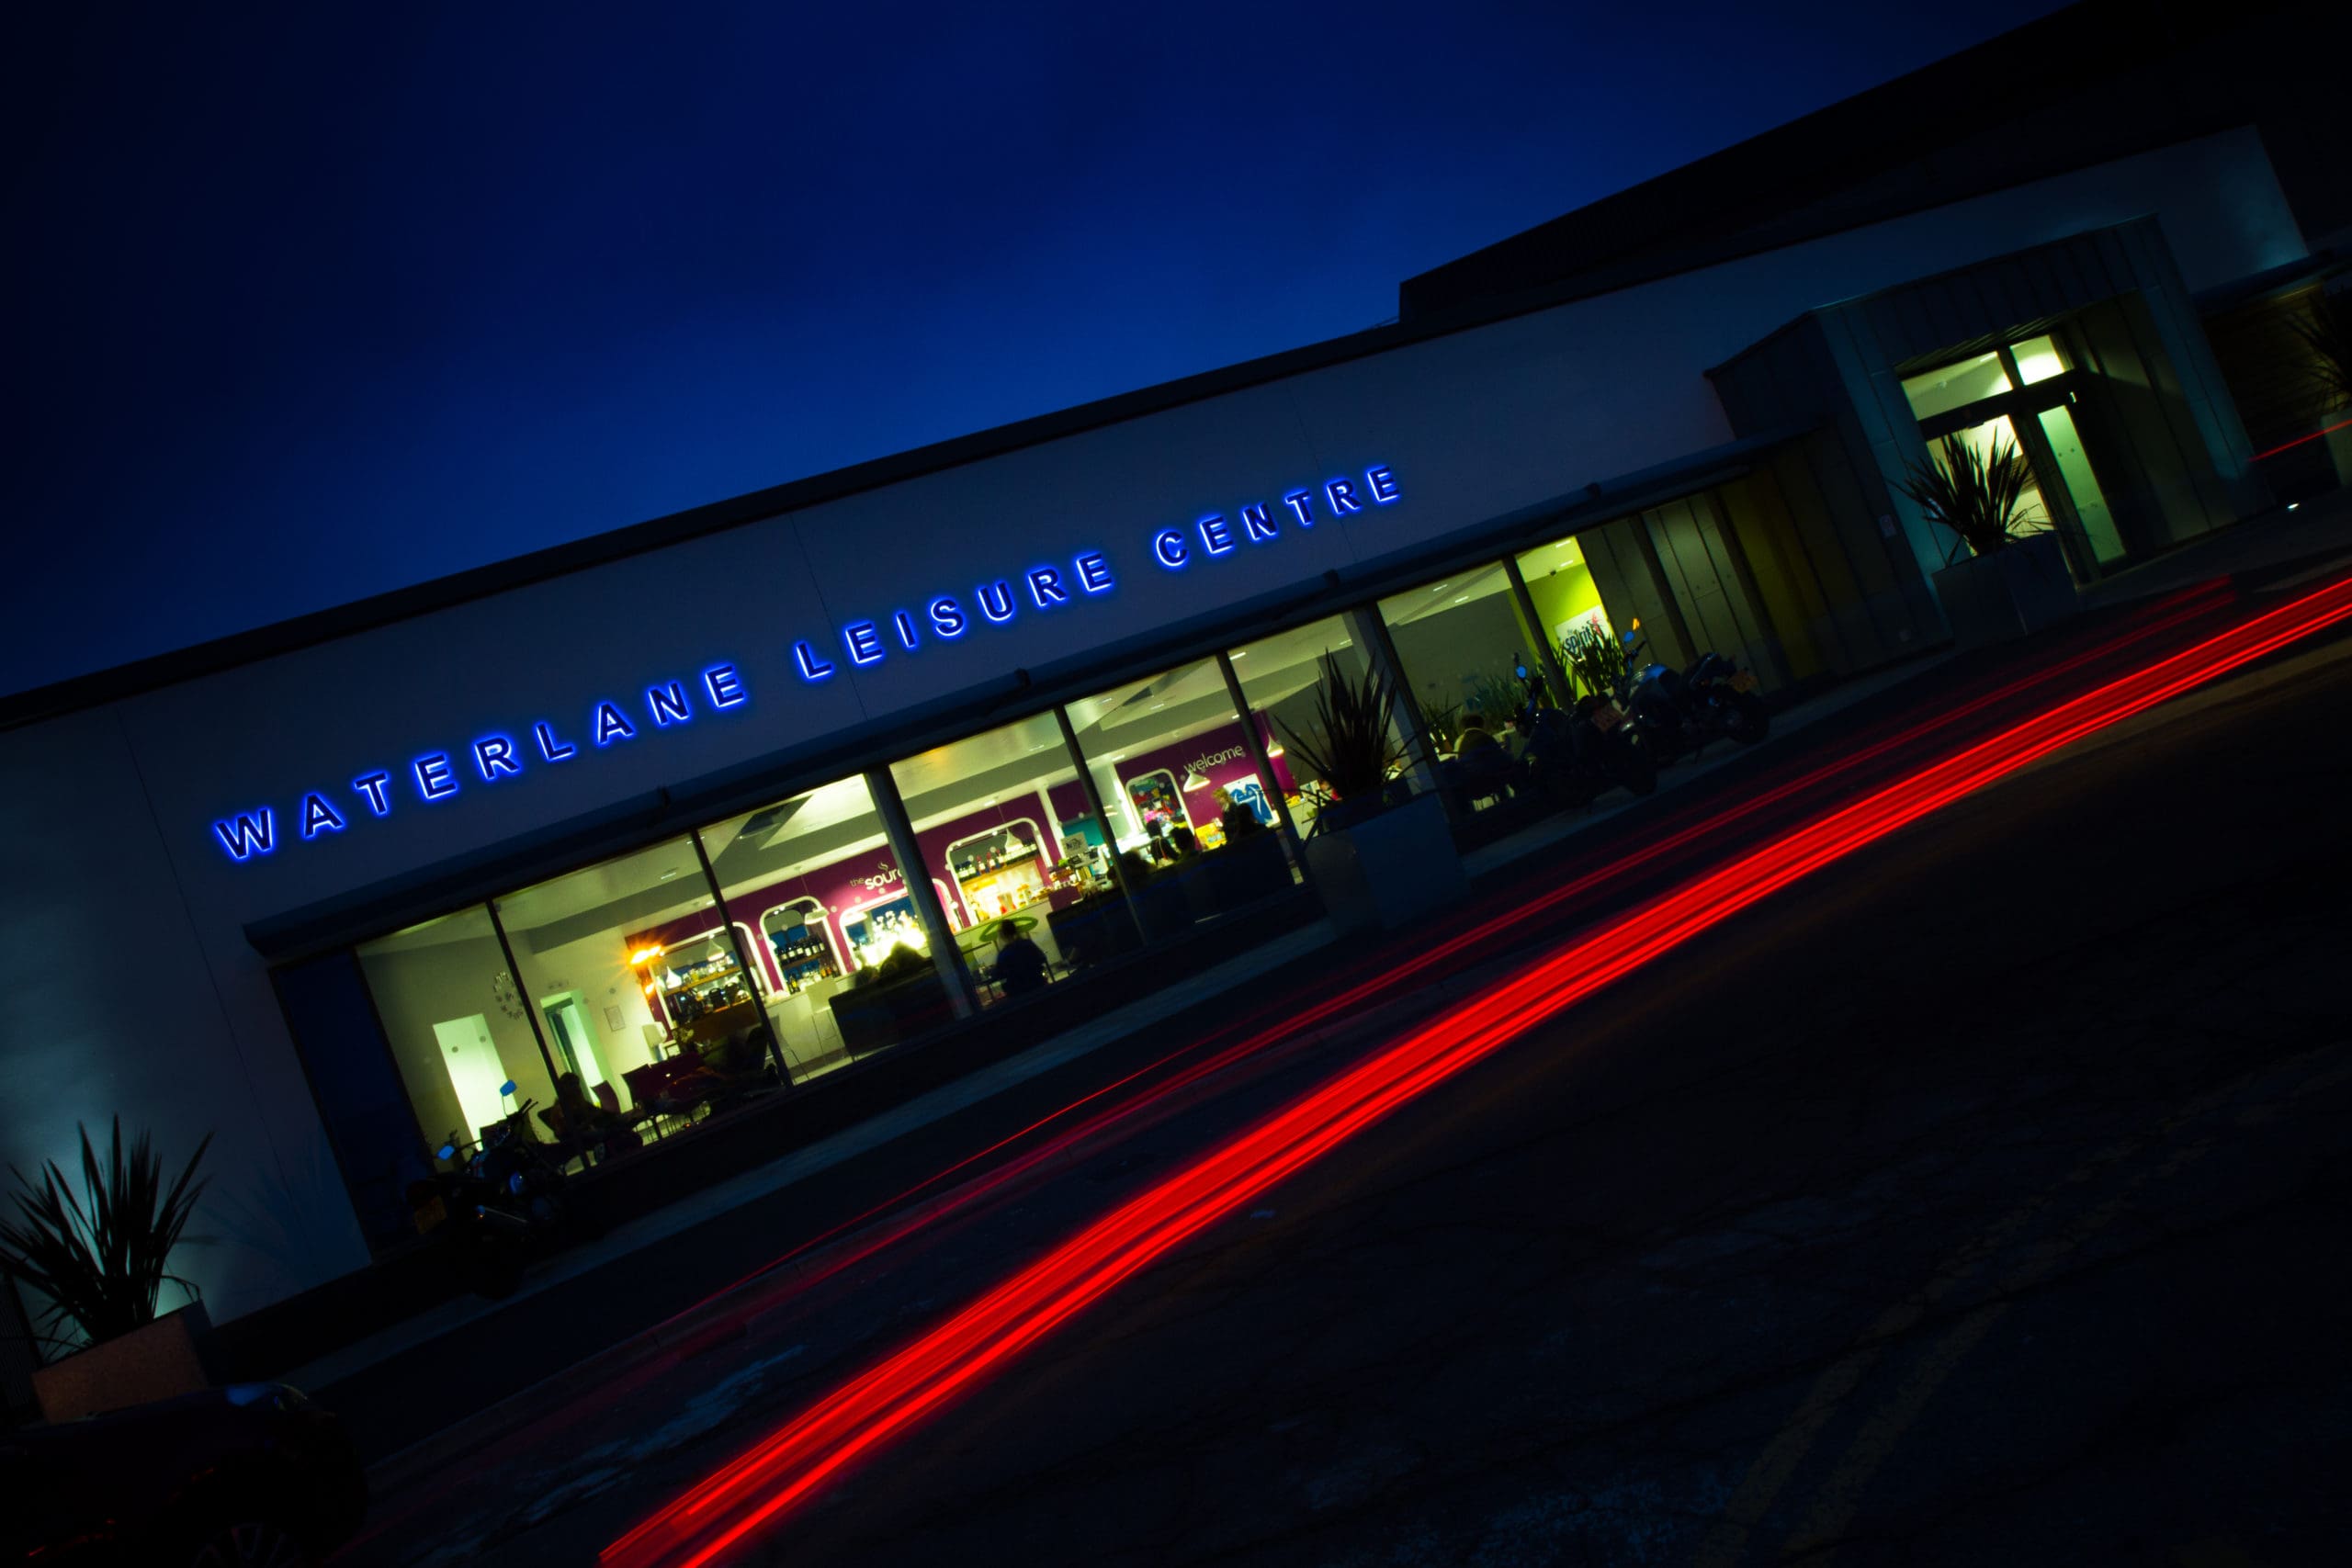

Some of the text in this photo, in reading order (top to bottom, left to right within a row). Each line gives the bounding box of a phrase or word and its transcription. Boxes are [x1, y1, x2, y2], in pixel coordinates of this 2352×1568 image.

[216, 465, 1400, 861] WATERLANE LEISURE CENTRE
[1183, 745, 1243, 773] welcome
